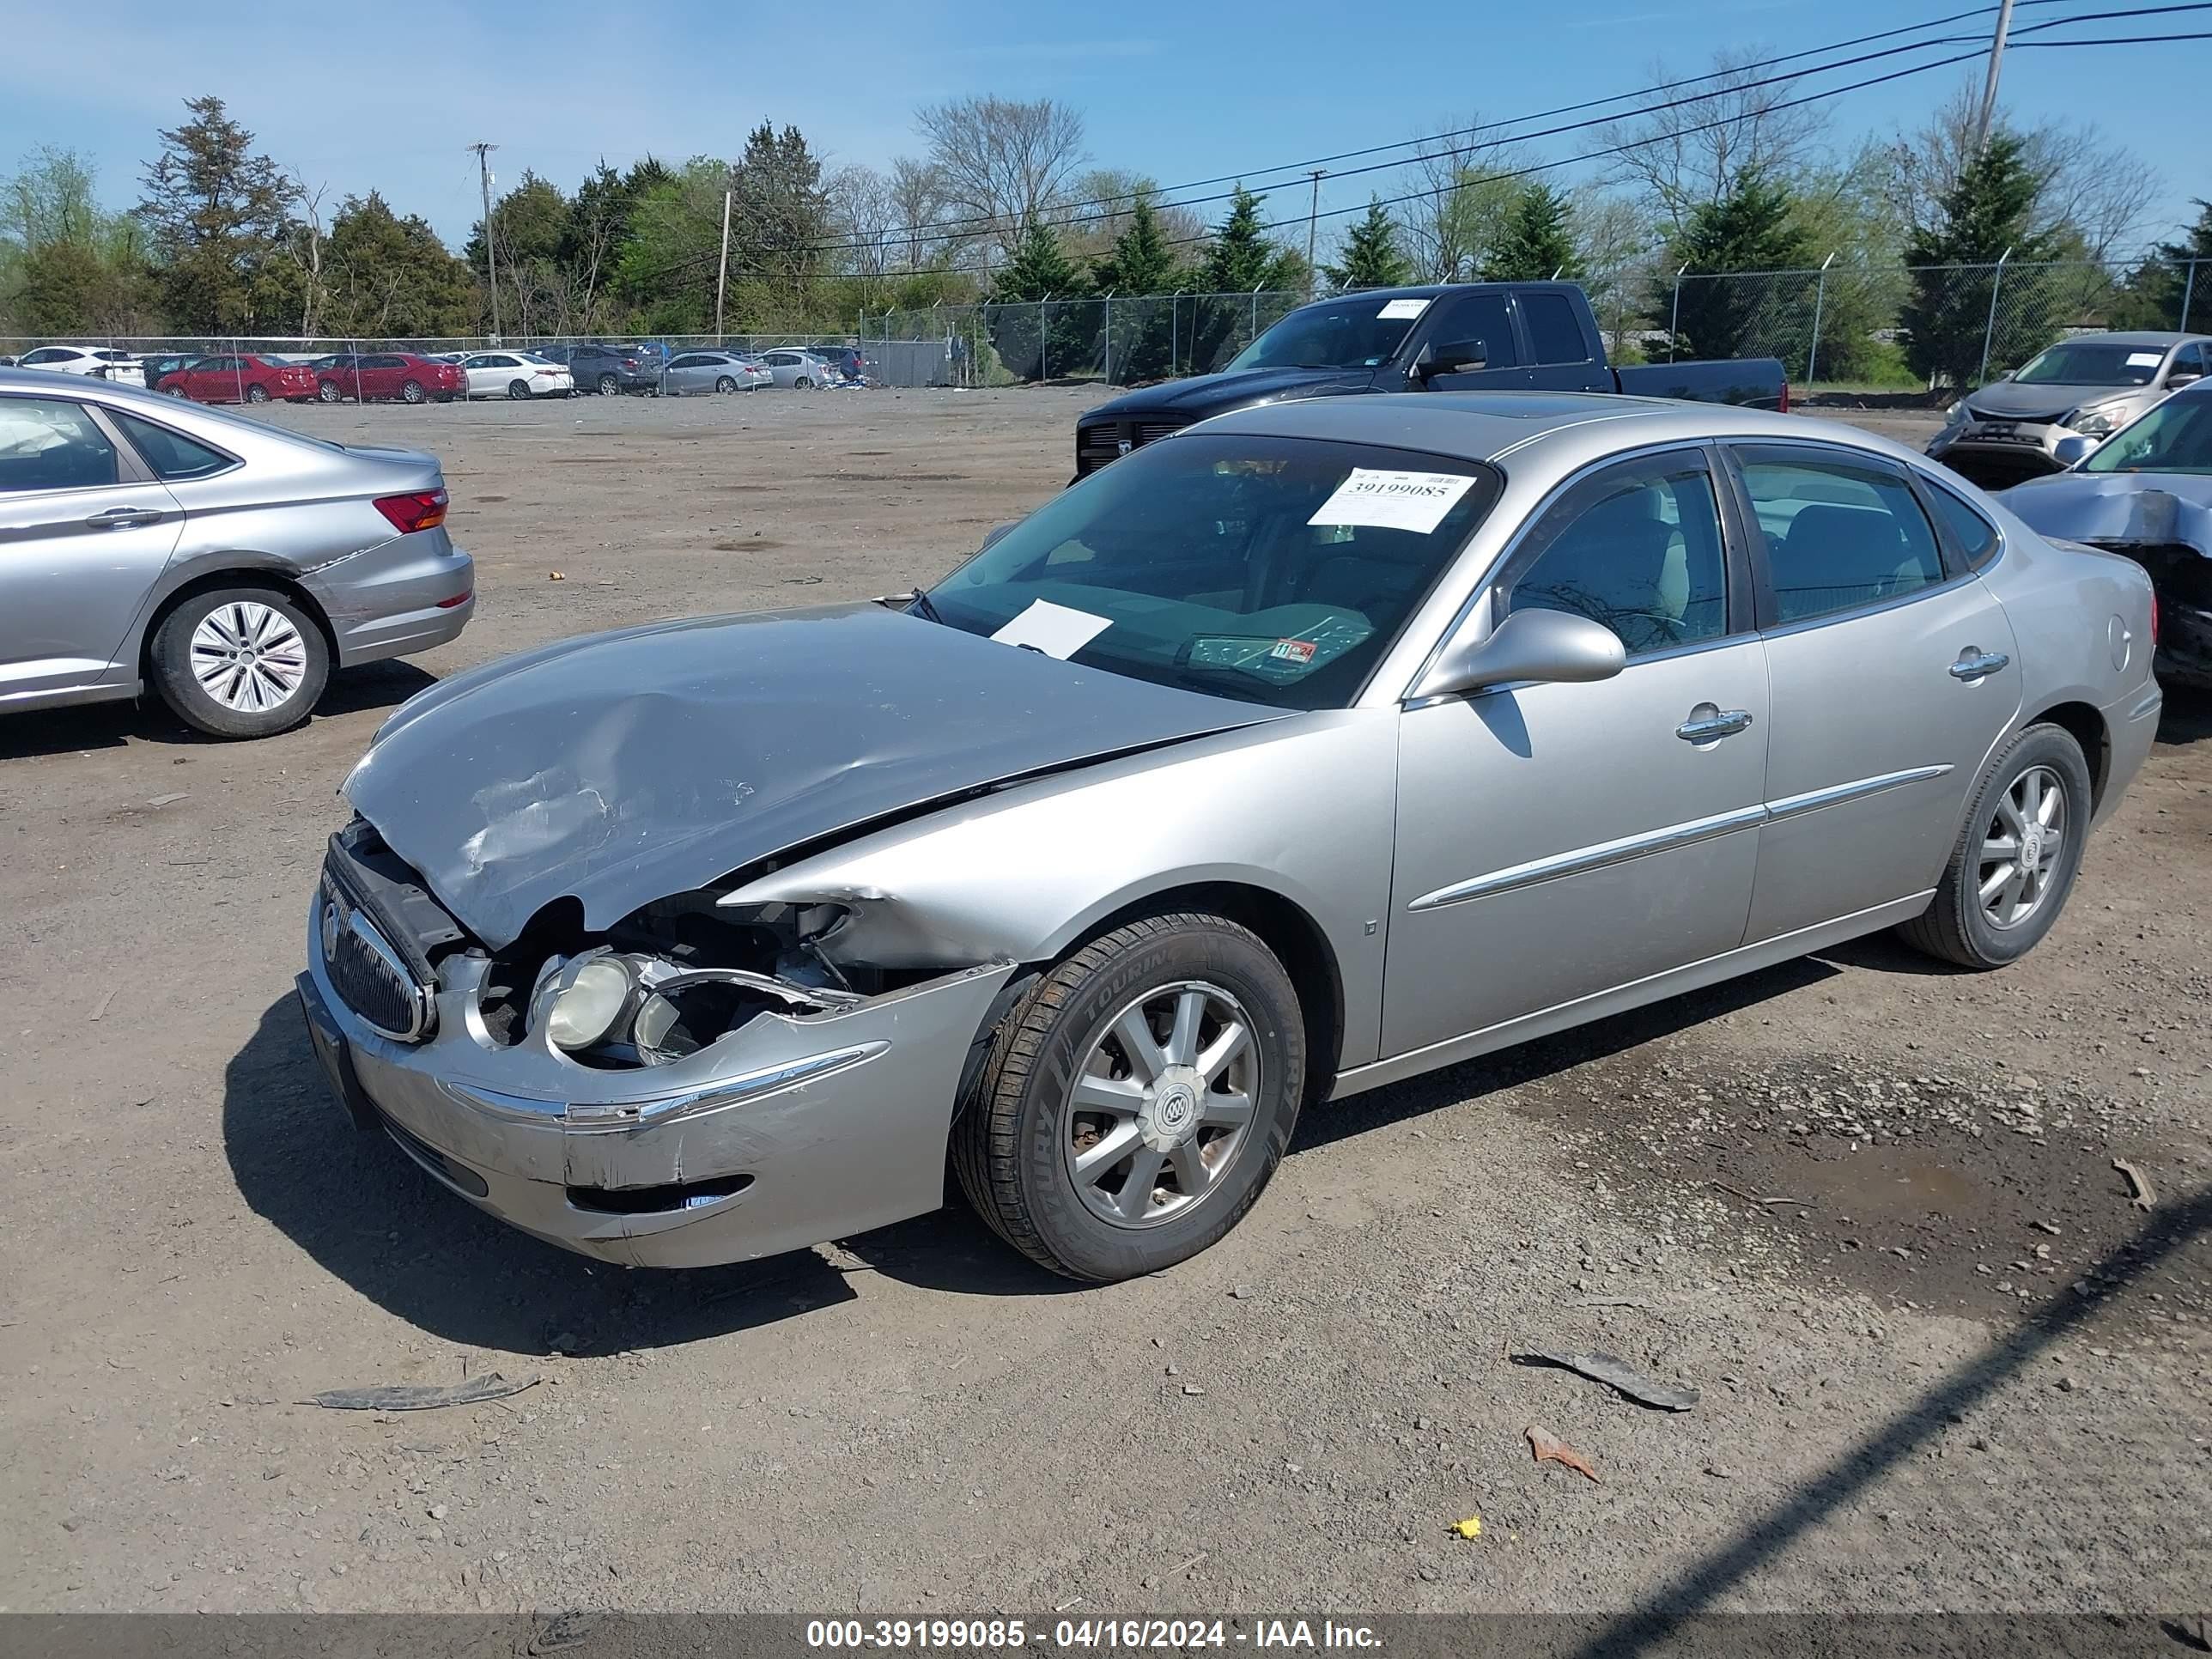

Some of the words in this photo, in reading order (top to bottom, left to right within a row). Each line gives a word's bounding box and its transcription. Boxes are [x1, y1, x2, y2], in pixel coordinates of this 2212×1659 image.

[1348, 482, 1449, 498] 39199085
[1276, 643, 1291, 656] 11
[1299, 647, 1314, 657] 24
